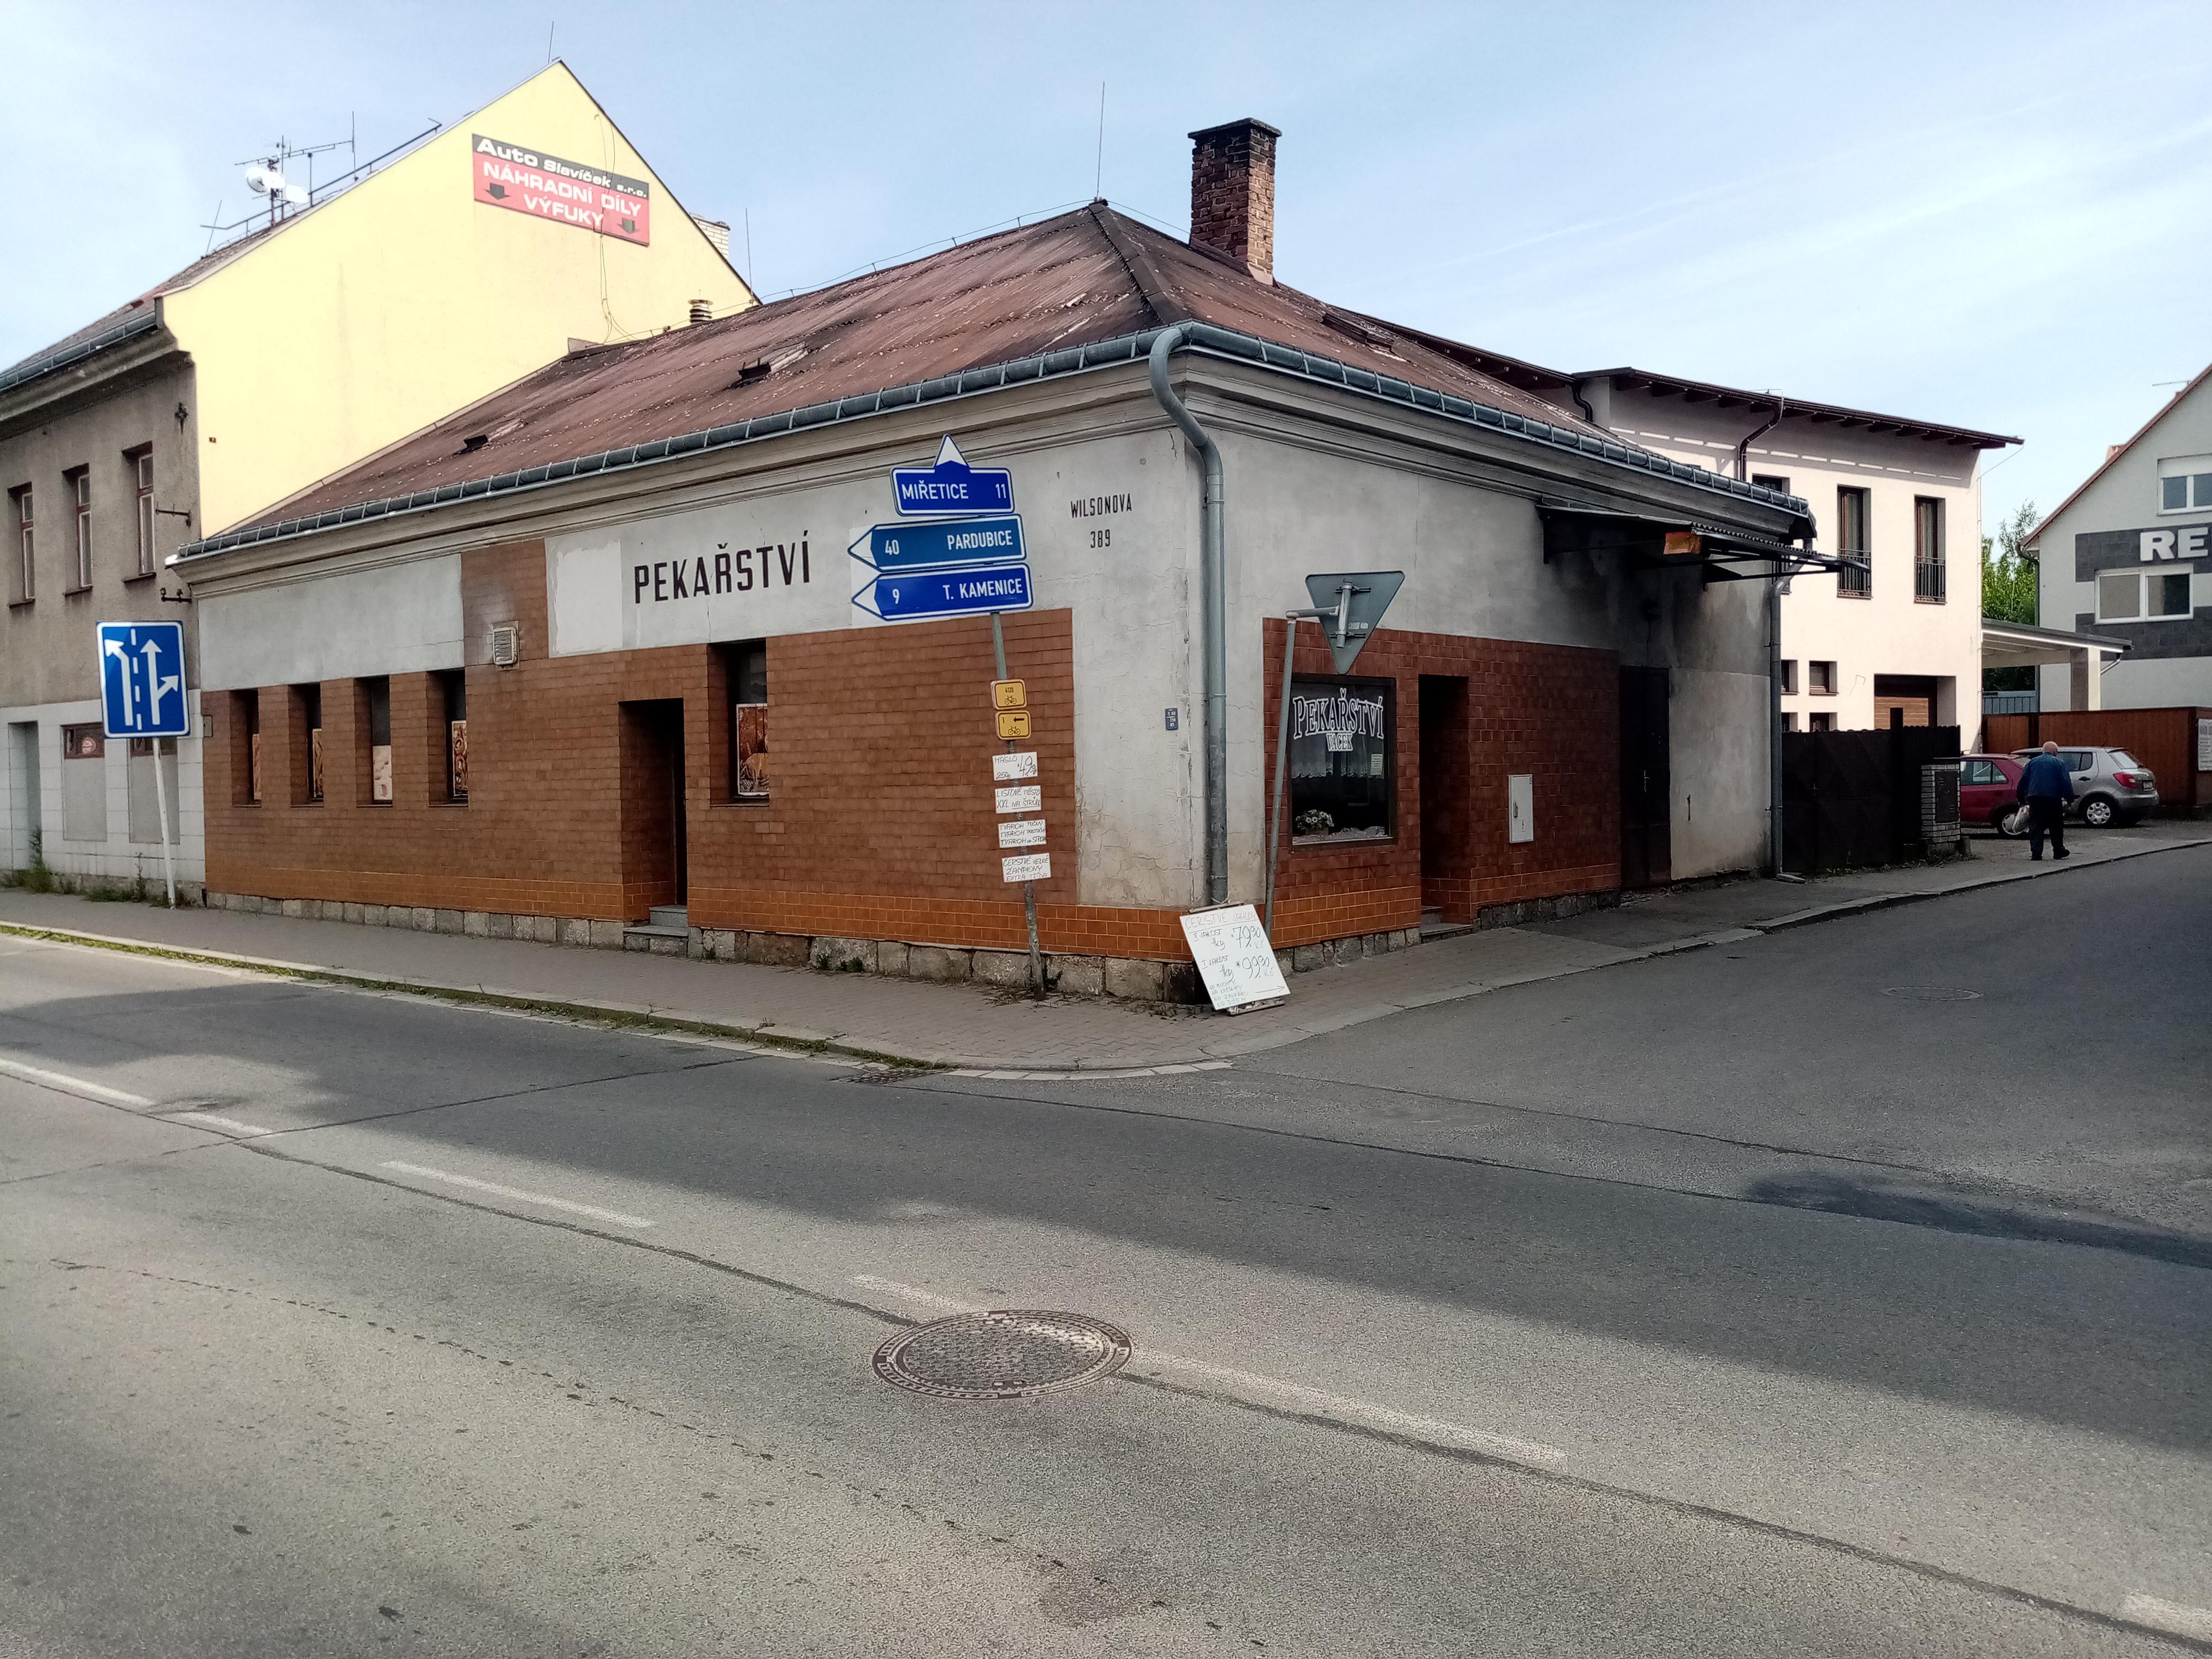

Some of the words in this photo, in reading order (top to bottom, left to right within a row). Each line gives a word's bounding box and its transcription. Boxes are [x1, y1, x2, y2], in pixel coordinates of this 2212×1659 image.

[476, 138, 539, 167] Auto
[543, 159, 612, 188] Slavíček
[617, 184, 647, 197] s.r.o.
[483, 161, 593, 204] NÁHRADNÍ
[601, 194, 641, 216] DÍLY
[524, 194, 604, 227] VÝFUKY
[901, 480, 969, 499] MIŘETICE
[995, 483, 1007, 499] 11
[1071, 493, 1132, 518] WILSONOVA
[885, 539, 900, 555] 40
[947, 530, 1013, 550] PARDUBICE
[1090, 529, 1110, 548] 389
[2140, 526, 2208, 561] RE
[634, 530, 810, 604] PEKAŘSTVÍ
[892, 588, 900, 604] 9
[942, 585, 954, 600] T.
[959, 578, 1023, 599] KAMENICE
[1292, 687, 1384, 740] PEKAŘSTVÍ
[1326, 733, 1353, 751] VACEK
[997, 800, 1009, 808] XXL
[1000, 838, 1027, 846] TVAROH
[1185, 910, 1228, 929] ČERSTVÉ
